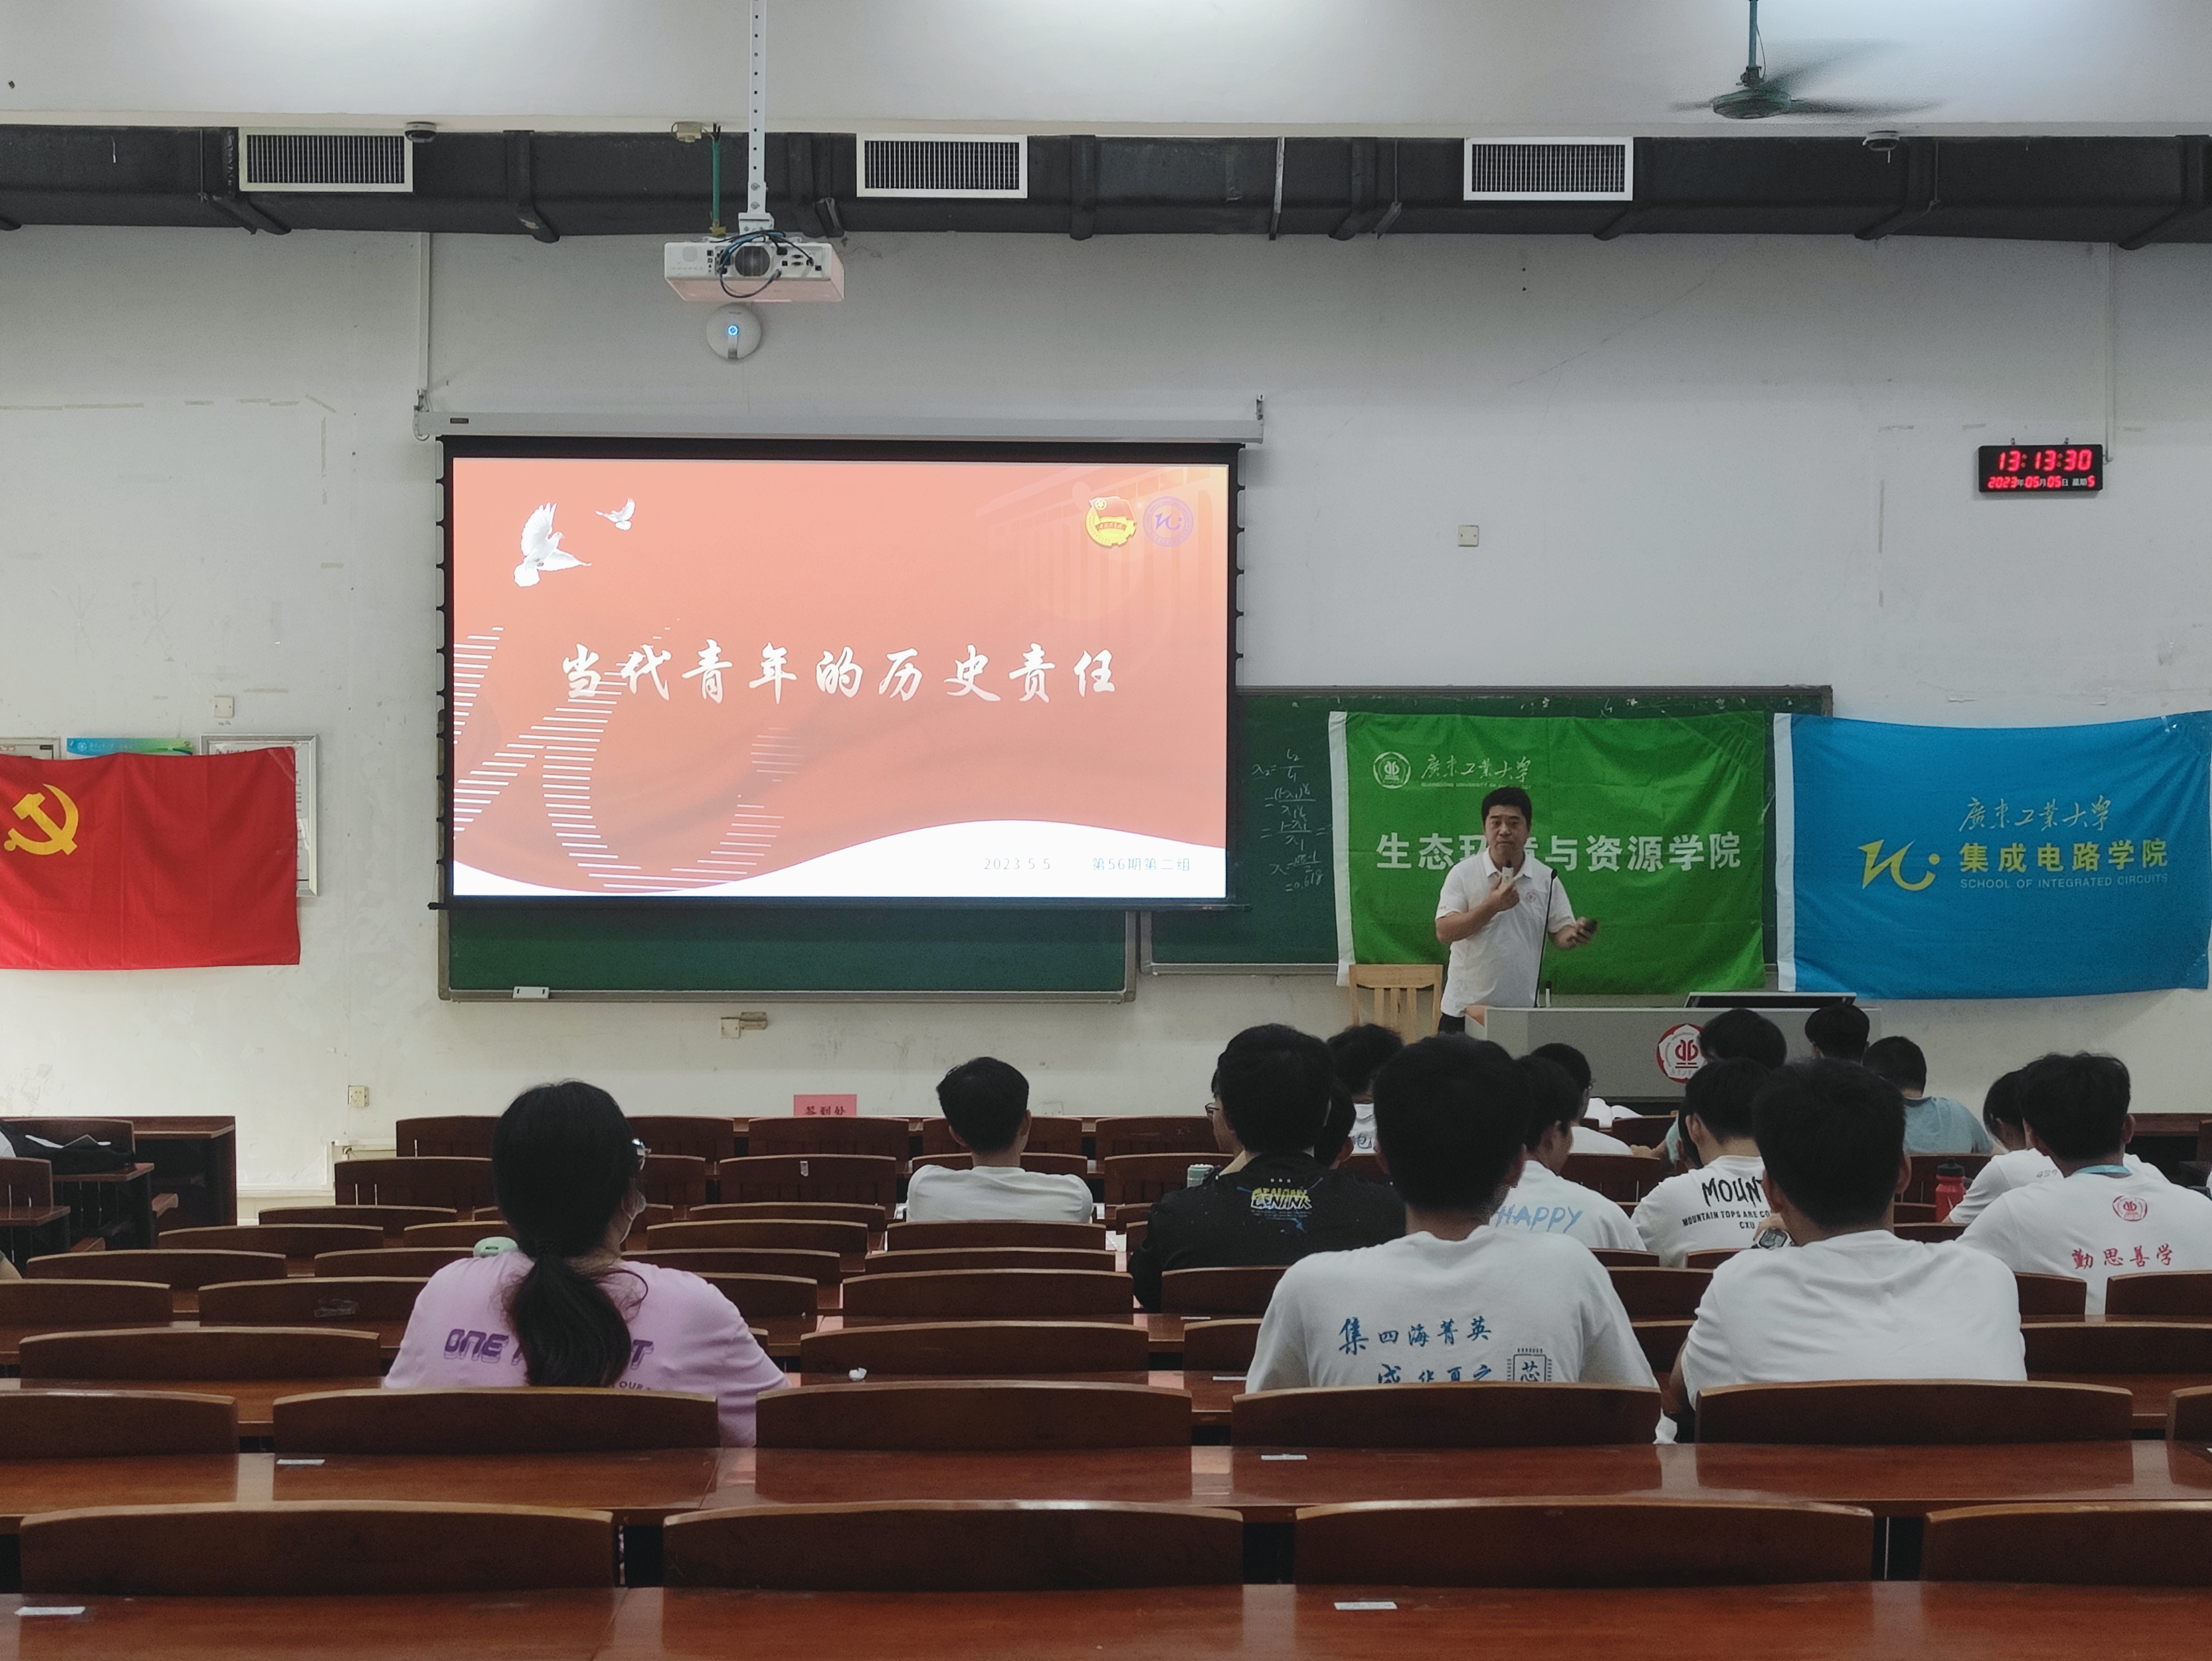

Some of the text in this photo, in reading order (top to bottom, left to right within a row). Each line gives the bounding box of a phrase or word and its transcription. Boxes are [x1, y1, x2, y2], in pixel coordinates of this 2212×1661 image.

[1998, 449, 2093, 472] 13:13:30
[562, 639, 1116, 704] 当代青年的历史责任
[984, 858, 1020, 870] 2023
[1093, 858, 1190, 871] 第56期第二组
[1375, 830, 1741, 872] 生态环与资源学院
[1959, 837, 2168, 874] 集成电路学院
[1960, 873, 2168, 889] SCHOOL OF INTEGRATED CIRCUITS
[1702, 1176, 1762, 1208] MOUN
[1495, 1204, 1583, 1234] HAPPY
[1682, 1211, 1719, 1227] MOUNTAIN
[2071, 1243, 2173, 1269] 勤思善学
[444, 1329, 509, 1363] ONE
[1339, 1316, 1492, 1355] 集四海菁英
